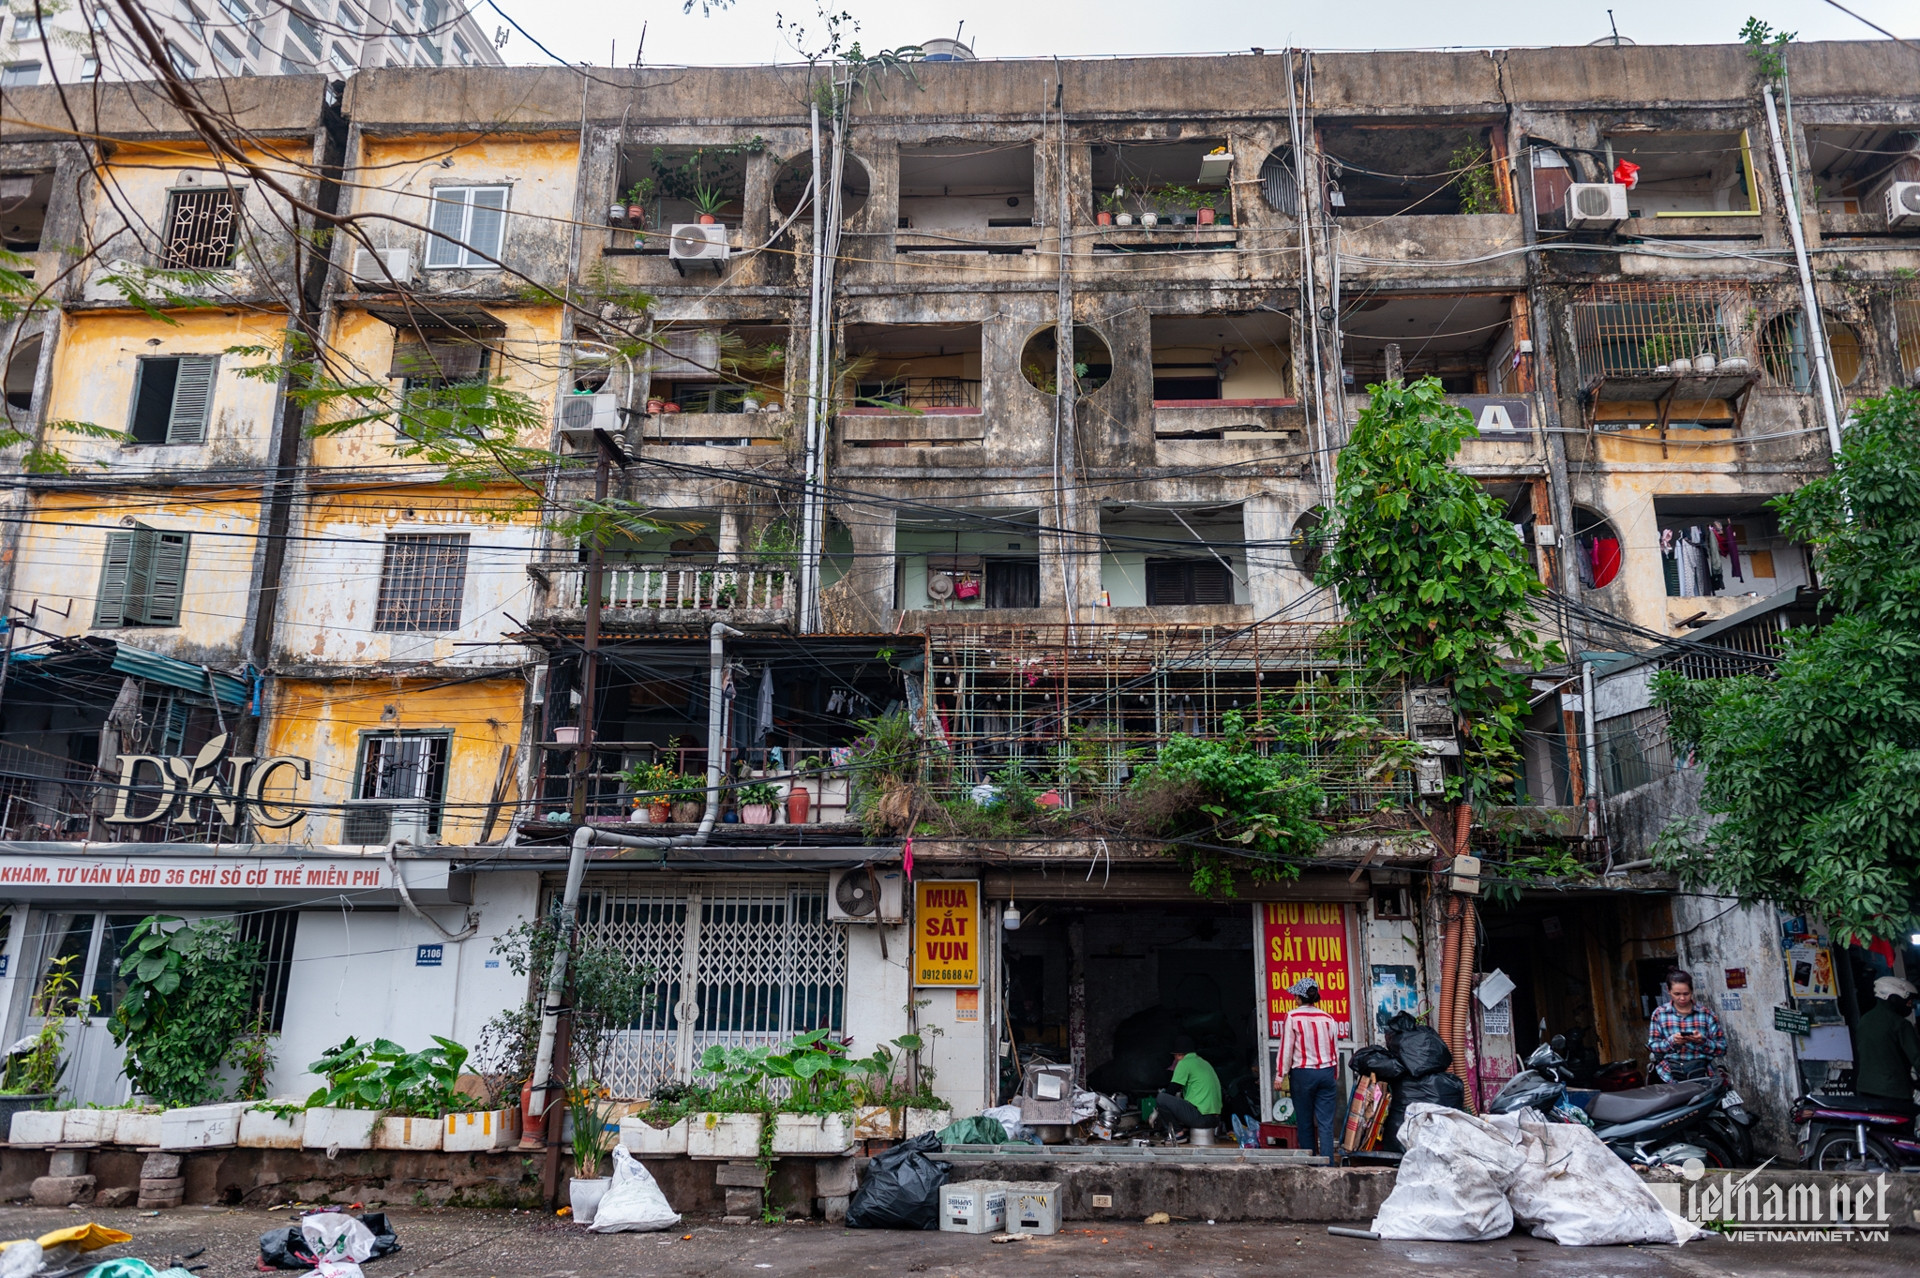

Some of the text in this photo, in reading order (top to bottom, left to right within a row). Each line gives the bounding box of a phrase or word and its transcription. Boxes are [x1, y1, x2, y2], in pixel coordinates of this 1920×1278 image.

[1477, 405, 1516, 434] A
[1, 863, 380, 886] KHÁM, TƯ VẤN VÀ ĐO 36 CHỈ SỐ CƠ THỂ MIỄN PHÍ
[926, 889, 968, 908] MUA
[926, 910, 968, 936] SẮT
[1267, 903, 1341, 925] THU MUA
[926, 942, 968, 965] VỤN
[1271, 927, 1342, 967] SẮT VỤN
[922, 969, 974, 981] 0912 6688 47
[1271, 965, 1290, 990] ĐỒ
[1327, 968, 1346, 990] CŨ
[1336, 997, 1348, 1014] LÝ
[948, 1197, 1006, 1210] SAPPHIRE APPHIRE
